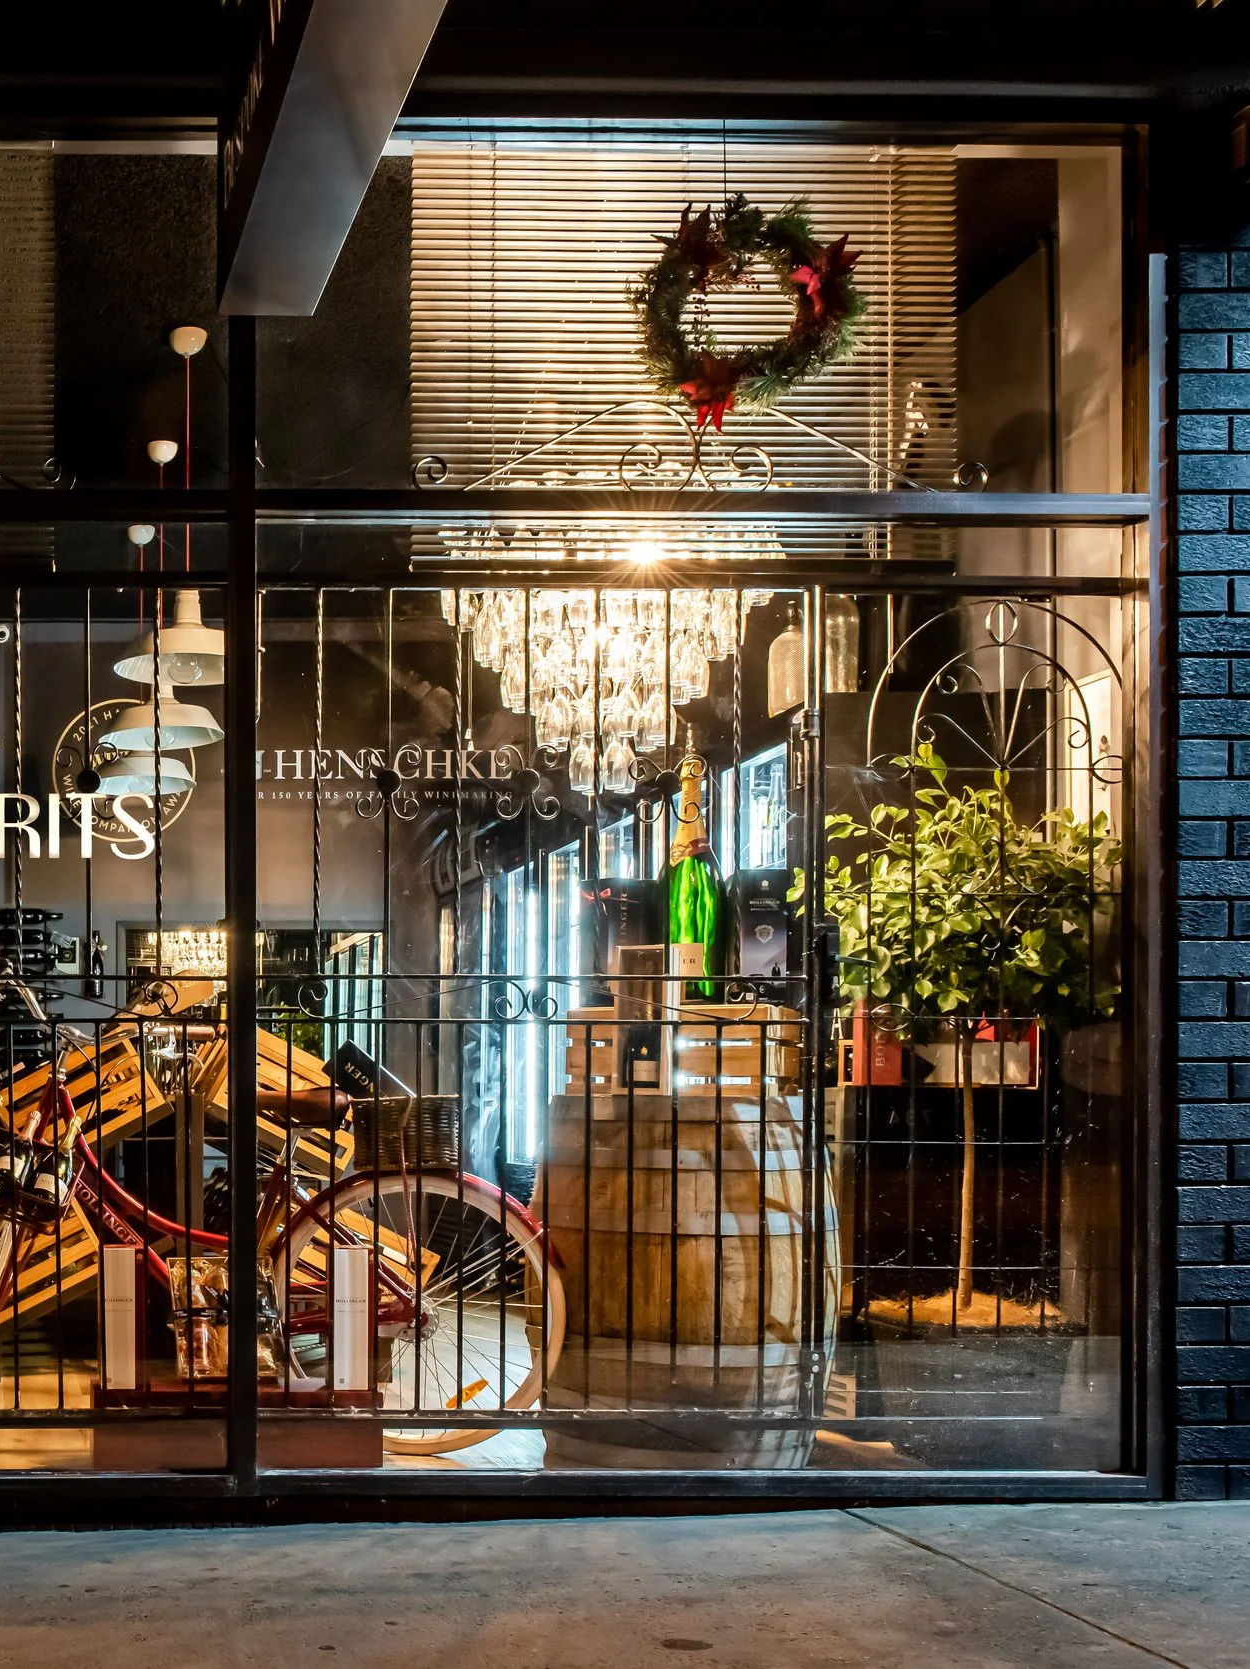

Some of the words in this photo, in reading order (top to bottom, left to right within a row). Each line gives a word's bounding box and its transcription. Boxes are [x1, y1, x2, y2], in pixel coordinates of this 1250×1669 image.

[272, 791, 291, 800] 150
[298, 791, 339, 800] YERS
[369, 791, 417, 800] FAILY
